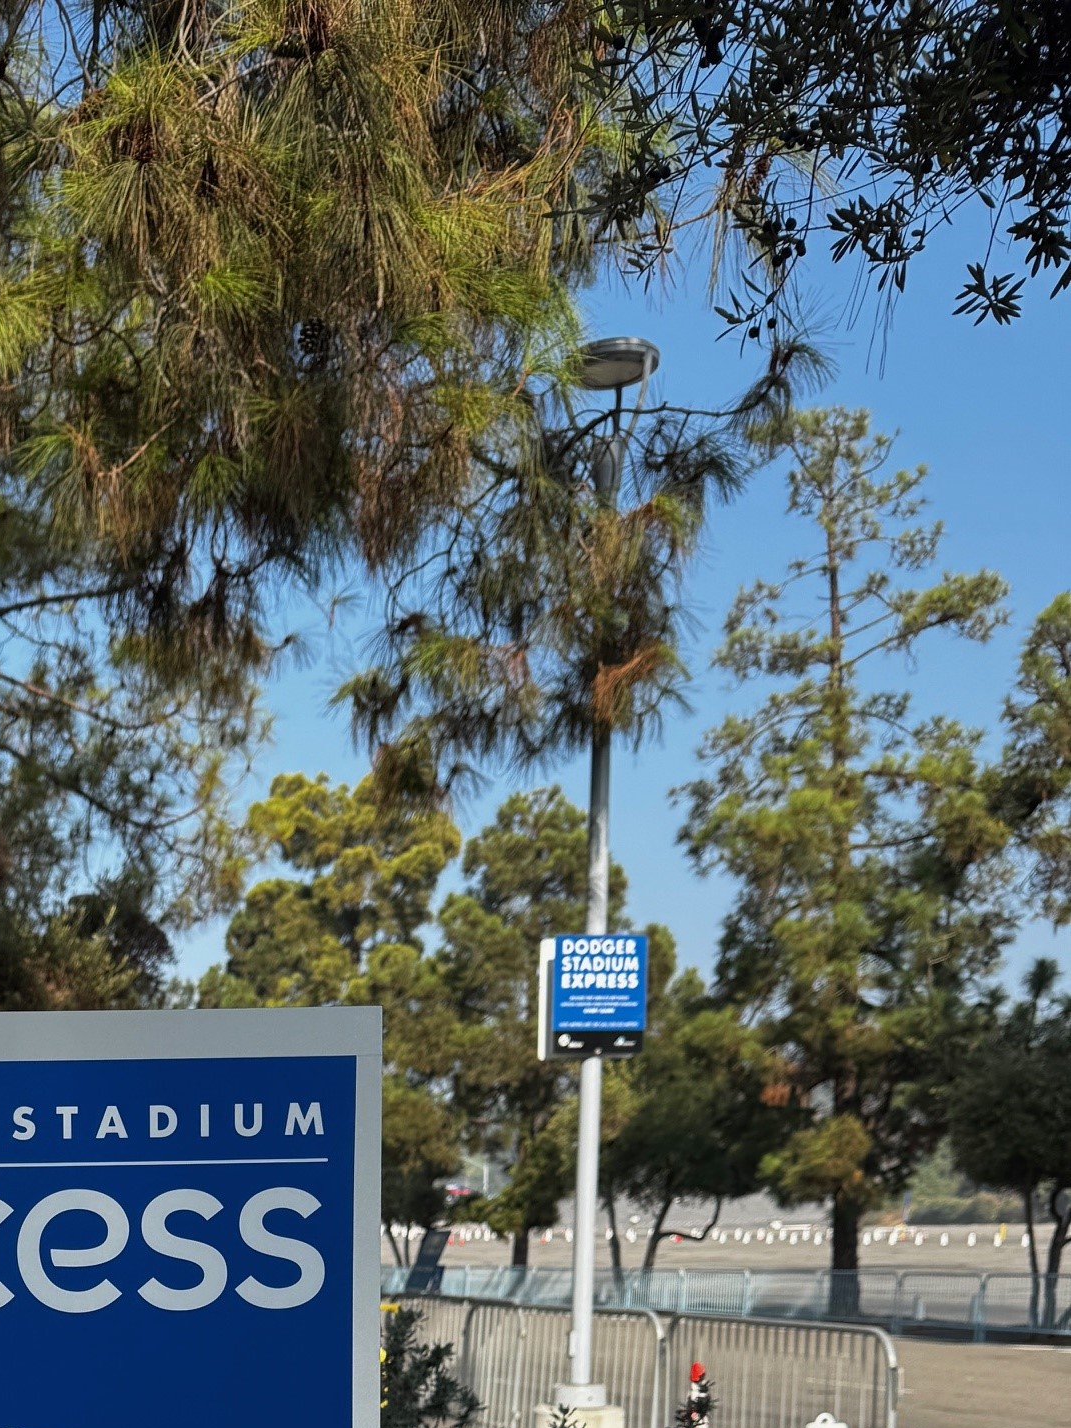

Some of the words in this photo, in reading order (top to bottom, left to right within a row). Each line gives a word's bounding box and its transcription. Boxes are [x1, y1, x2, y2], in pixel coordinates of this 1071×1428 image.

[562, 938, 636, 955] DODGER
[561, 956, 639, 972] STADIUM
[561, 972, 639, 989] EXPRESS
[12, 1102, 324, 1140] STADIUM
